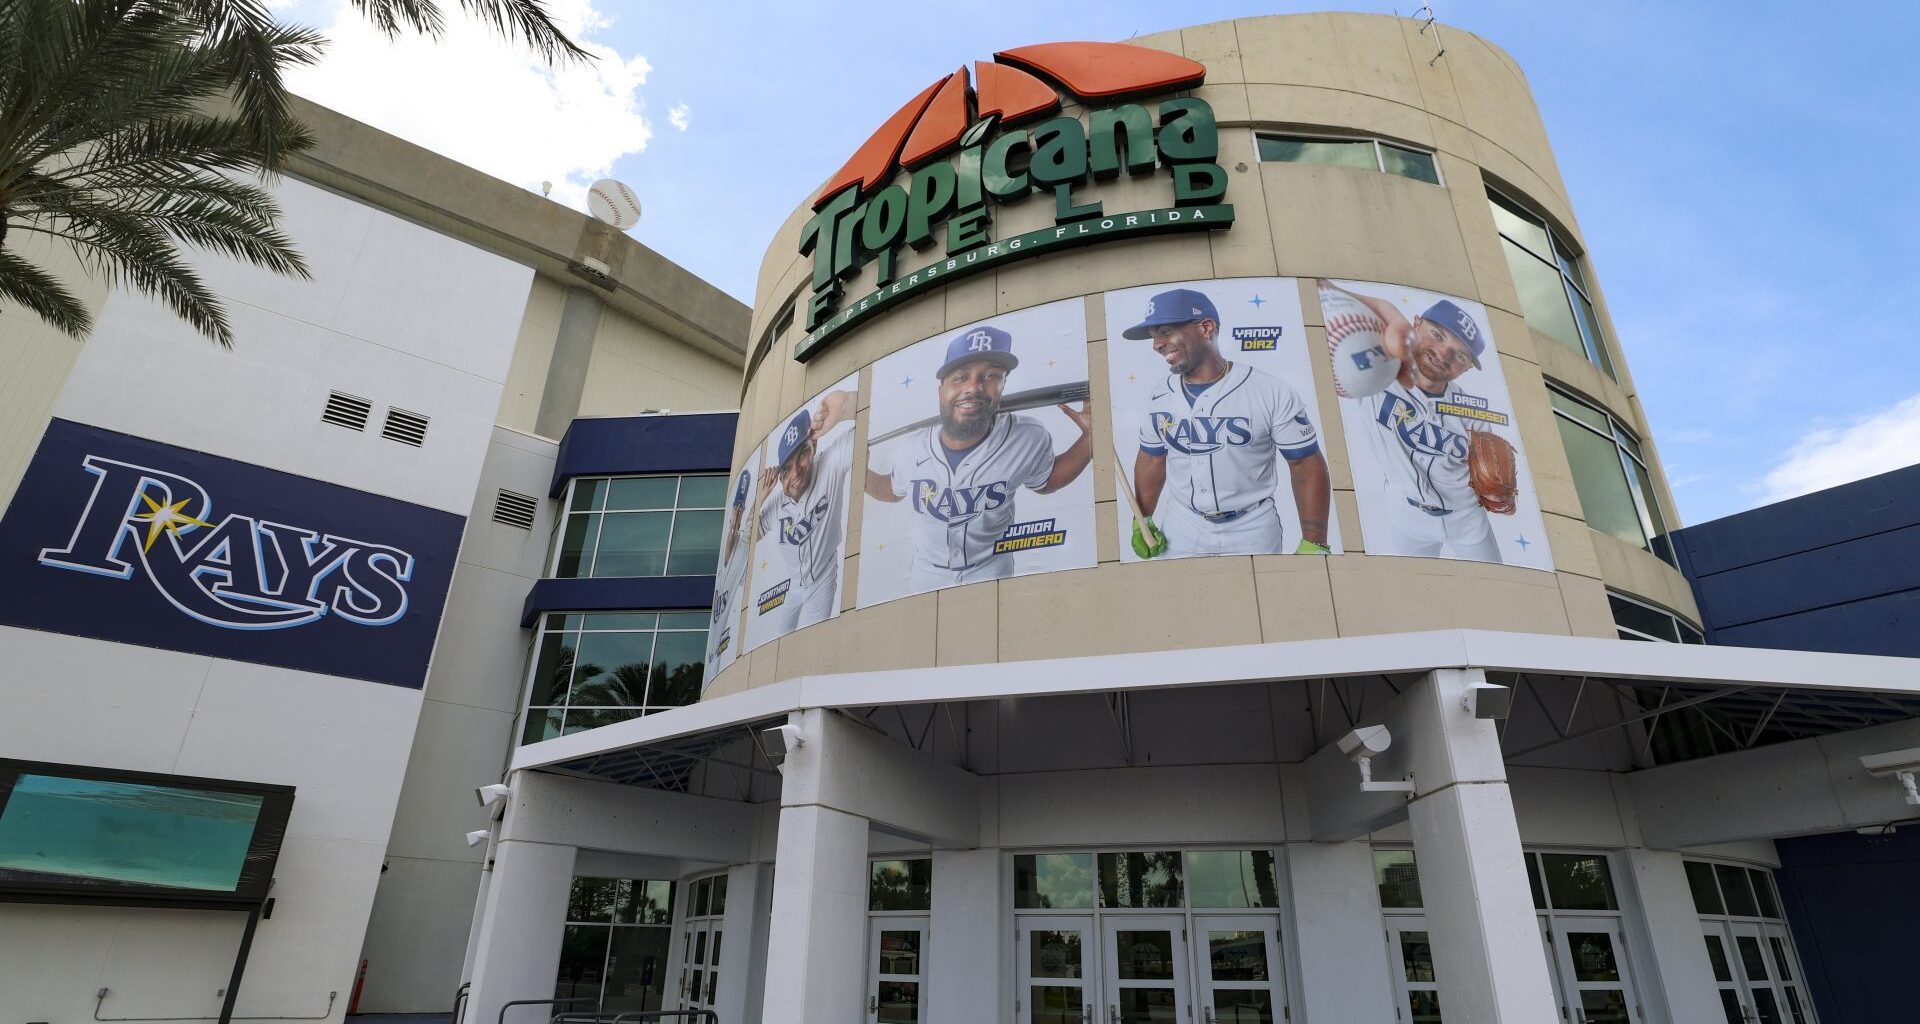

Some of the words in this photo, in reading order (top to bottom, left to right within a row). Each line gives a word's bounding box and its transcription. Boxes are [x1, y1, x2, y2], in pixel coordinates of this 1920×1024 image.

[799, 97, 1219, 293] Tropicana
[805, 162, 1229, 334] FIELD
[808, 324, 836, 344] ST.
[1056, 209, 1205, 239] FLORIDA
[966, 330, 992, 351] TB
[1234, 328, 1280, 338] YANDY
[1456, 310, 1477, 341] TB
[1437, 403, 1507, 425] RASMUSSEN
[1453, 394, 1487, 409] DREW
[1149, 411, 1253, 455] RAYS
[1376, 390, 1469, 460] RAYS
[778, 495, 829, 546] RAYS
[910, 478, 1008, 528] RAYS
[38, 454, 415, 631] RAYS
[995, 532, 1064, 553] CAMINERO
[1005, 521, 1053, 538] JUNIOR
